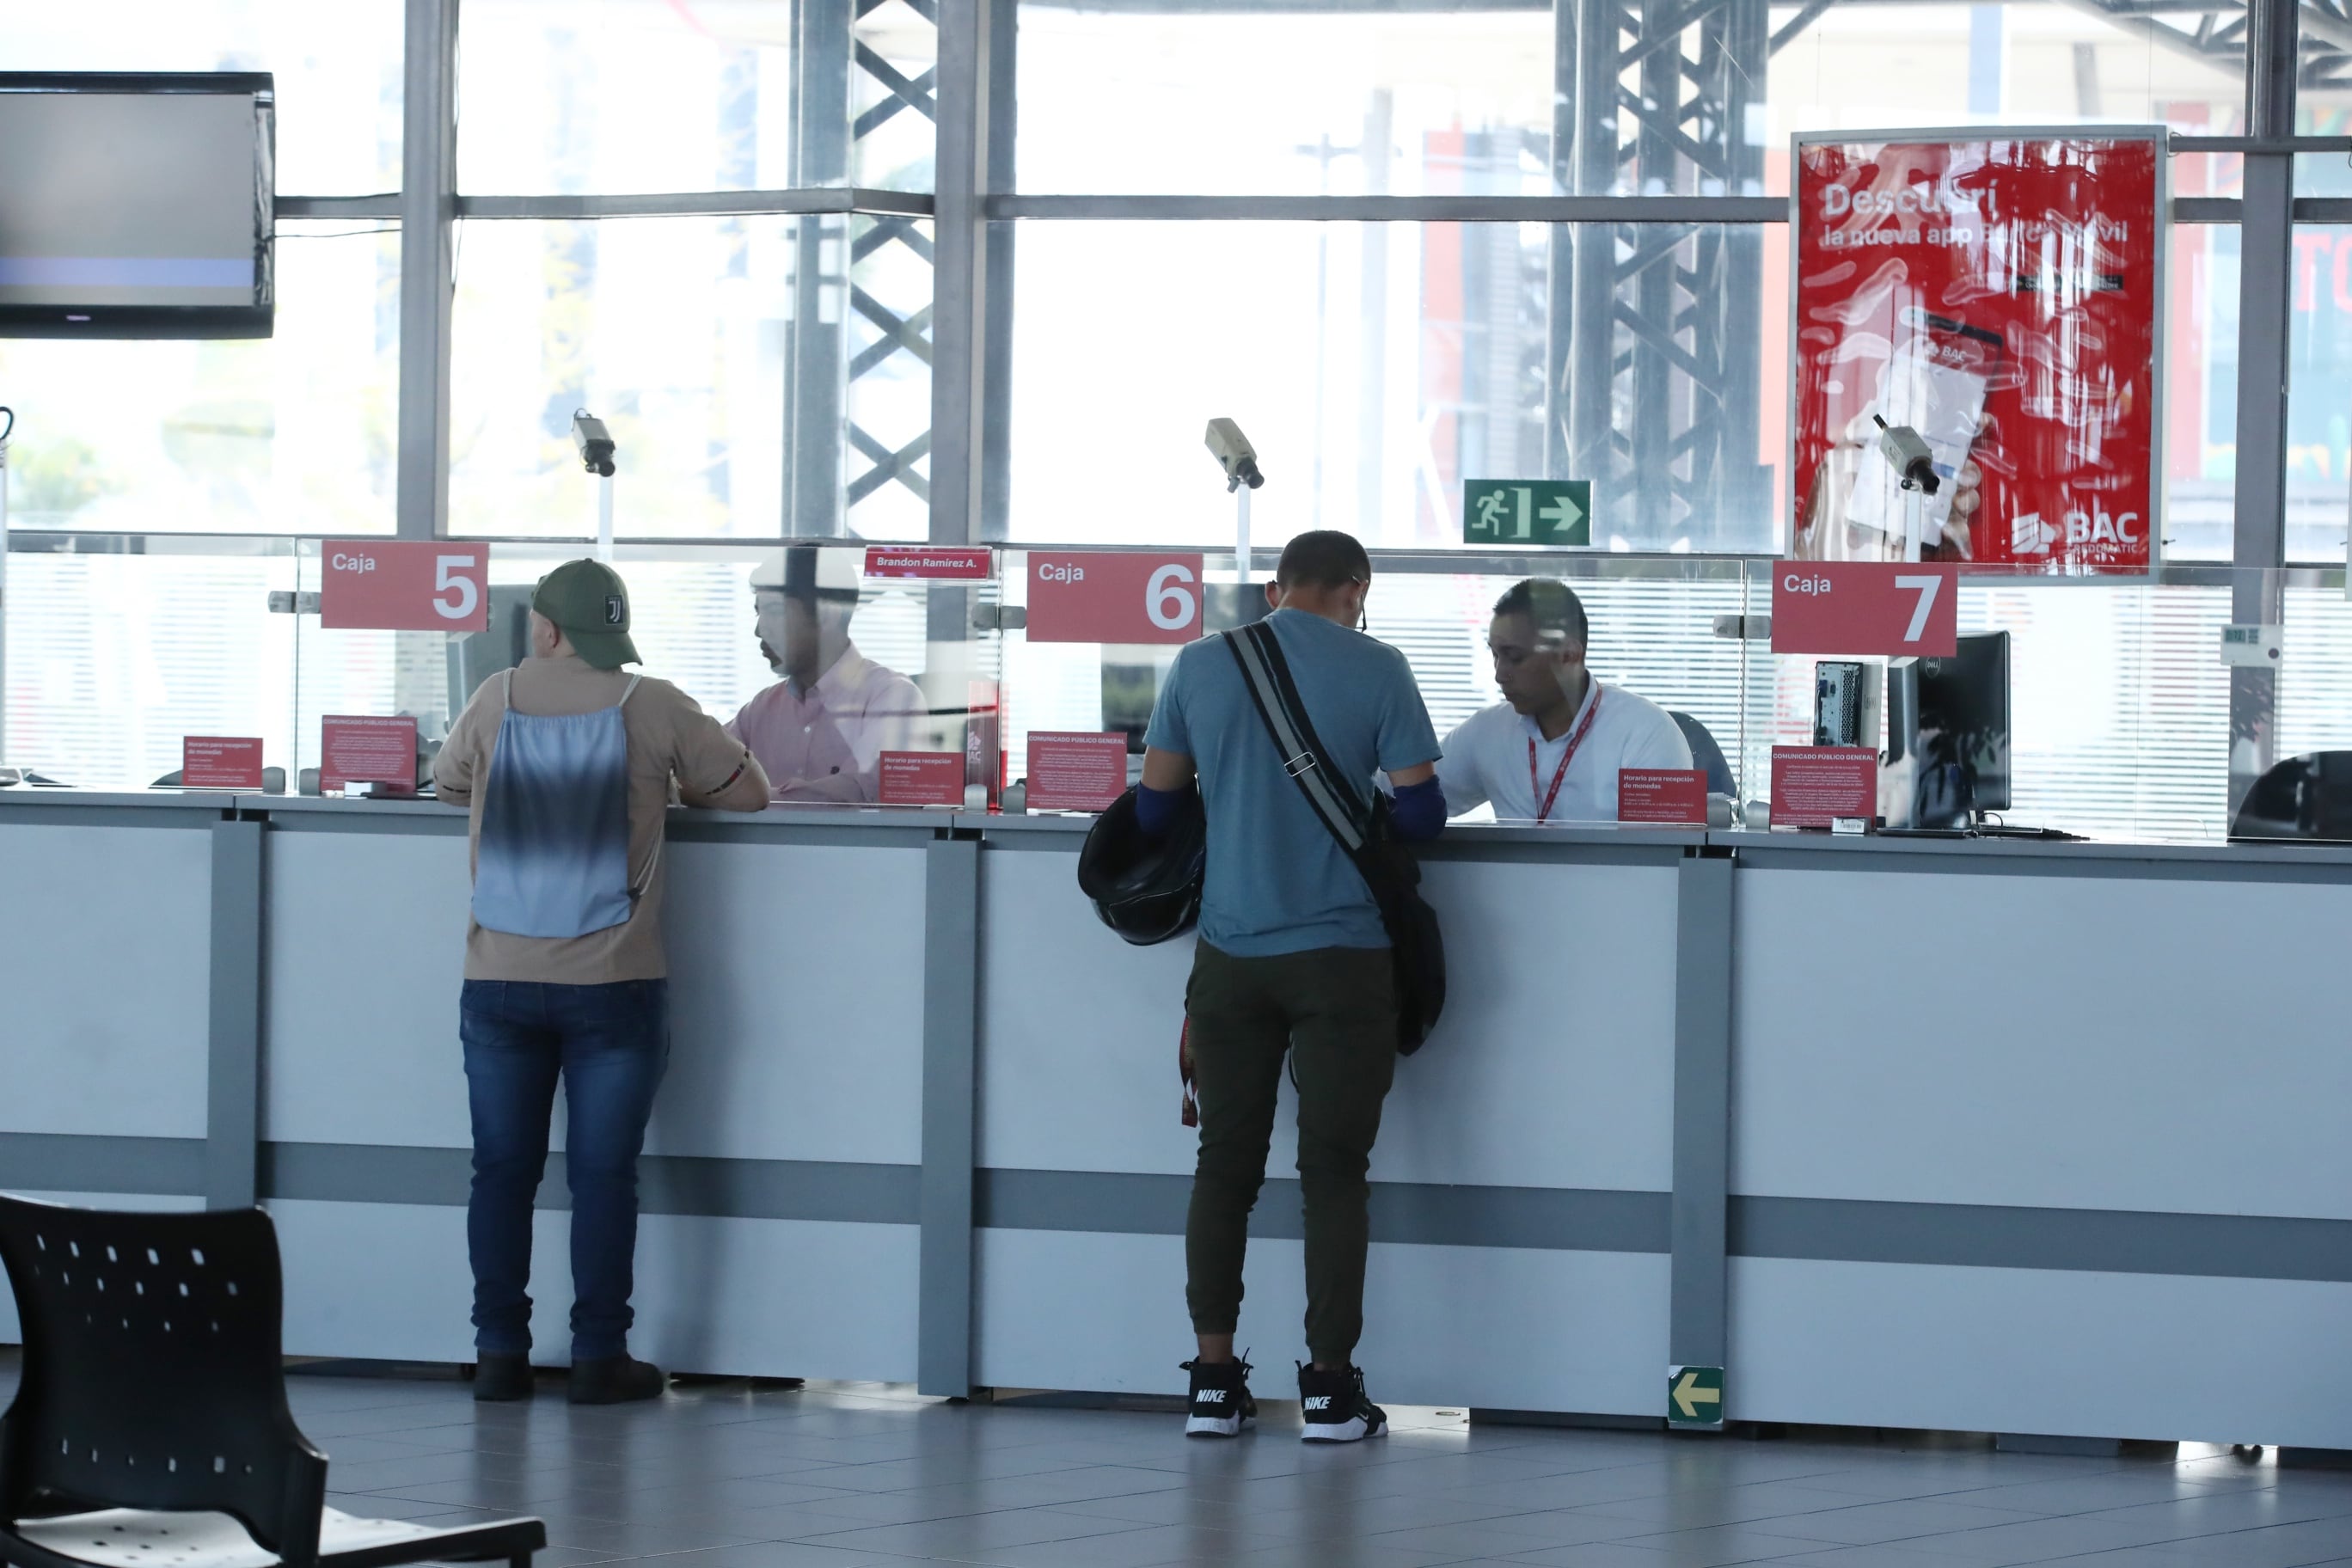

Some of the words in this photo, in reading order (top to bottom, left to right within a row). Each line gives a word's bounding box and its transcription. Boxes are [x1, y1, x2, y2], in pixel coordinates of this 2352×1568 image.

[1825, 179, 1999, 214] Descurí
[1824, 224, 1844, 246] la
[1849, 227, 1921, 246] nueva
[1926, 226, 1974, 248] app
[1981, 222, 2053, 242] Bnca
[2061, 220, 2128, 242] Mvil
[1942, 345, 1967, 361] BAC
[2067, 511, 2138, 543] BAC
[877, 556, 920, 567] Brandon
[922, 557, 964, 567] Ramírez
[965, 559, 977, 567] A.
[332, 553, 376, 574] Caja
[432, 555, 478, 619] 5
[1038, 562, 1084, 585] Caja
[1145, 564, 1196, 630] 6
[1784, 573, 1831, 596] Caja
[1895, 575, 1943, 641] 7
[1663, 775, 1694, 783] recepción
[1196, 1389, 1227, 1402] NIKE
[1304, 1396, 1332, 1410] NIKE
